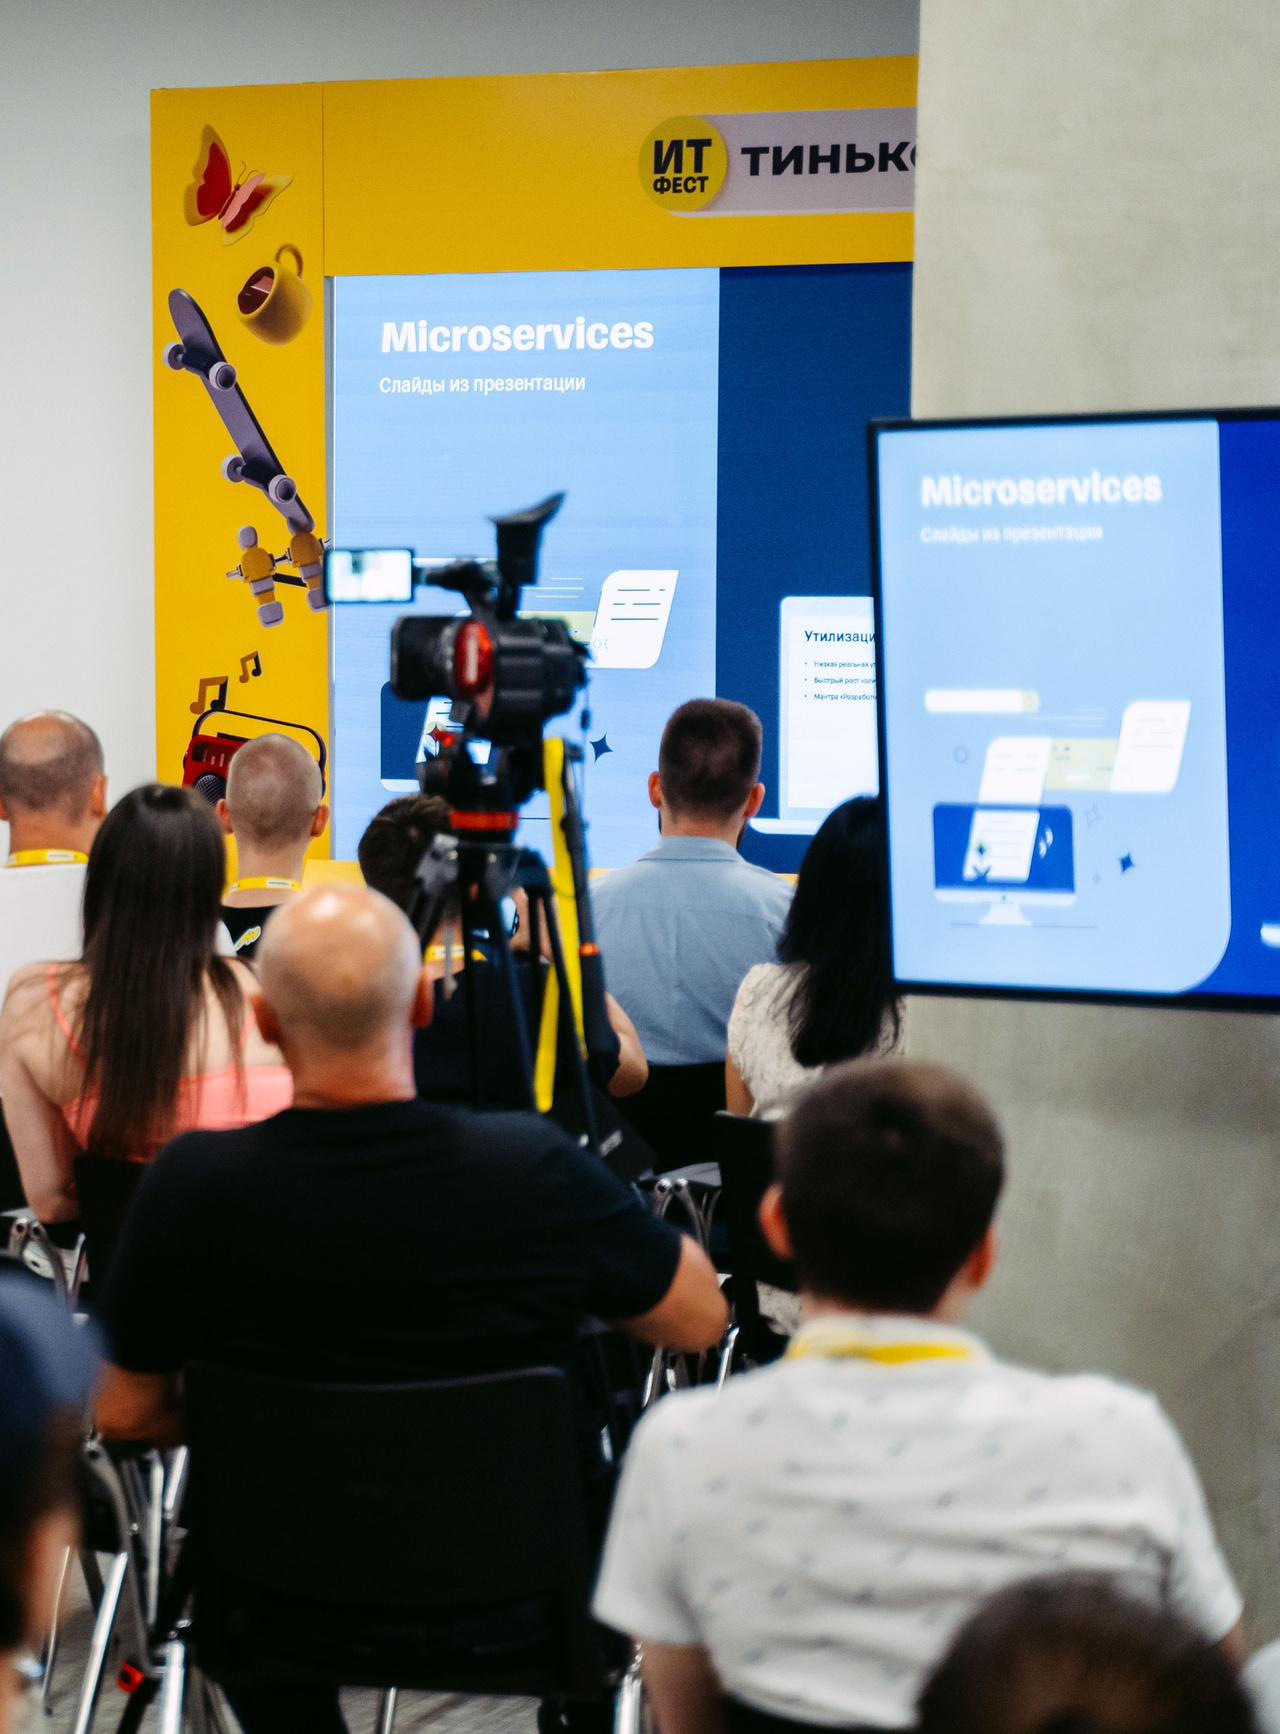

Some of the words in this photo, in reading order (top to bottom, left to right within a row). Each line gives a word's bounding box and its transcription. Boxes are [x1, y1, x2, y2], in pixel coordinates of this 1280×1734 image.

[653, 138, 712, 174] ИТ
[741, 141, 916, 176] ТИНЬК
[653, 176, 709, 194] ФЕСТ
[381, 316, 655, 353] Microservices
[379, 377, 445, 395] Слайды
[450, 380, 470, 392] из
[474, 377, 586, 395] презентации
[920, 469, 1163, 507] Microservices
[920, 526, 979, 543] Слайды
[982, 528, 1000, 541] из
[1003, 526, 1103, 543] презентации
